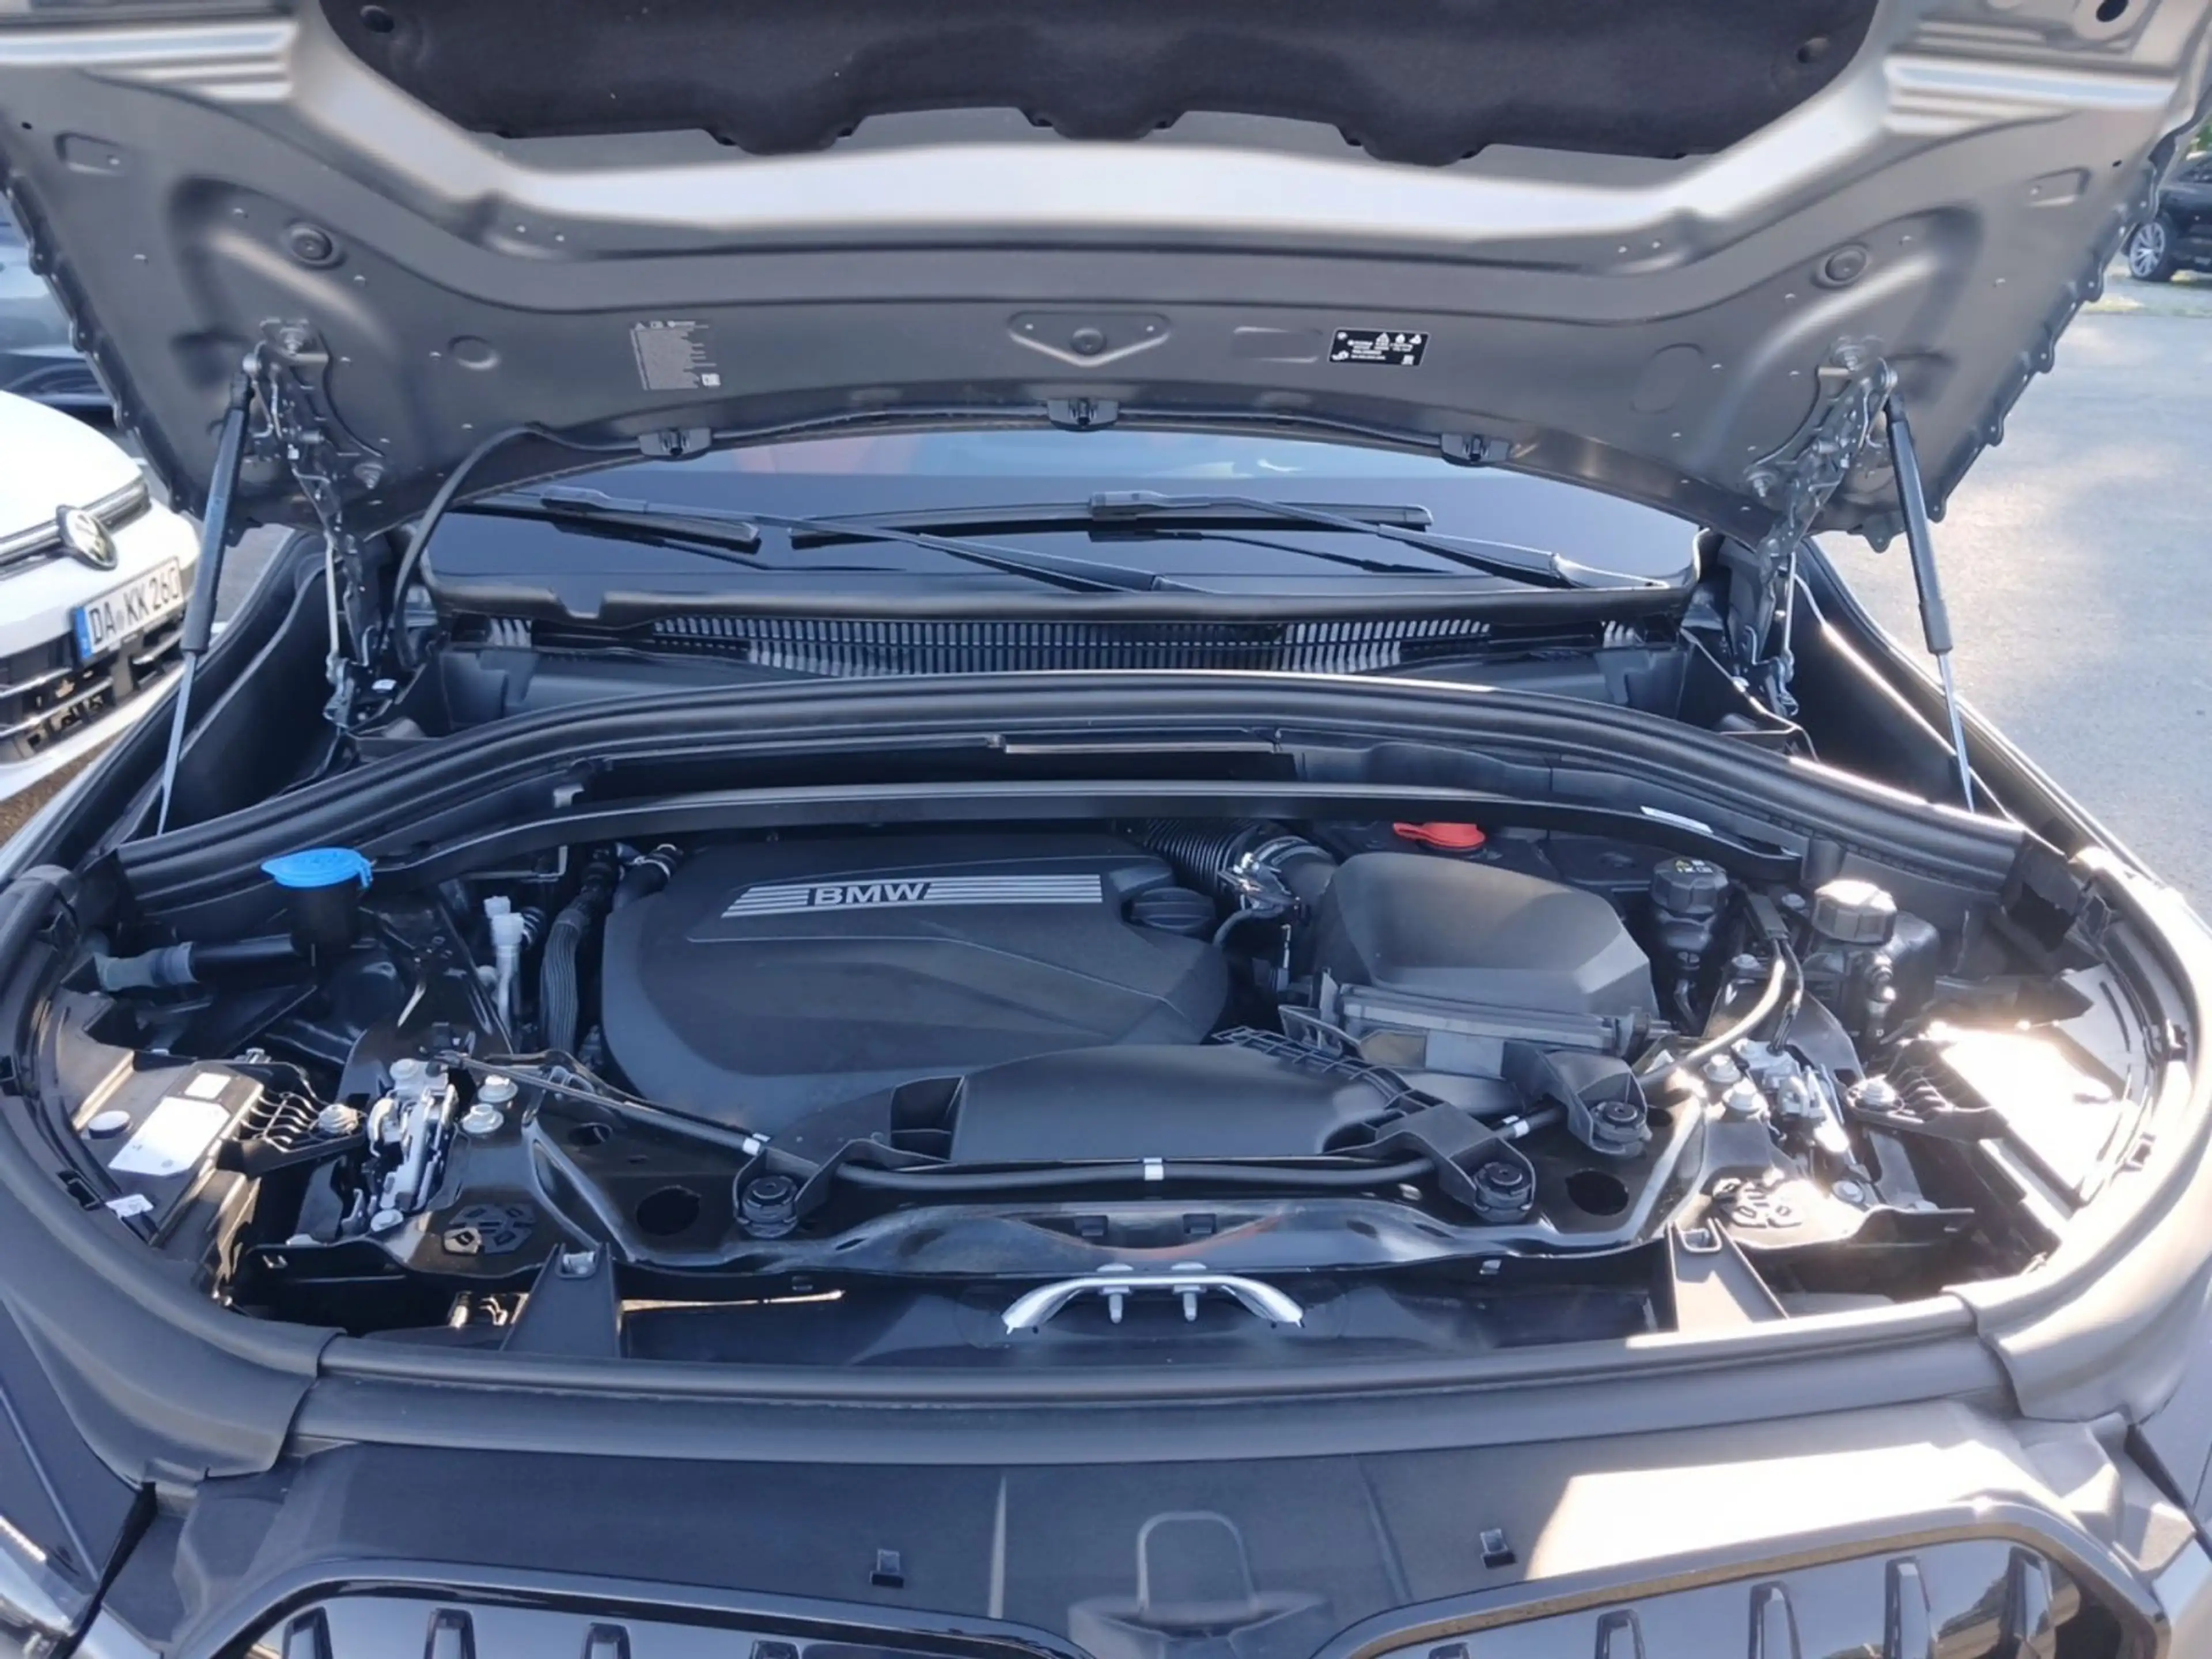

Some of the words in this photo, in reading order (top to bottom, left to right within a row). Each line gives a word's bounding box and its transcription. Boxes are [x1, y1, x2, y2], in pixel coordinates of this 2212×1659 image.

[89, 601, 116, 645] DA
[123, 584, 149, 626] KK
[815, 883, 925, 906] BMW
